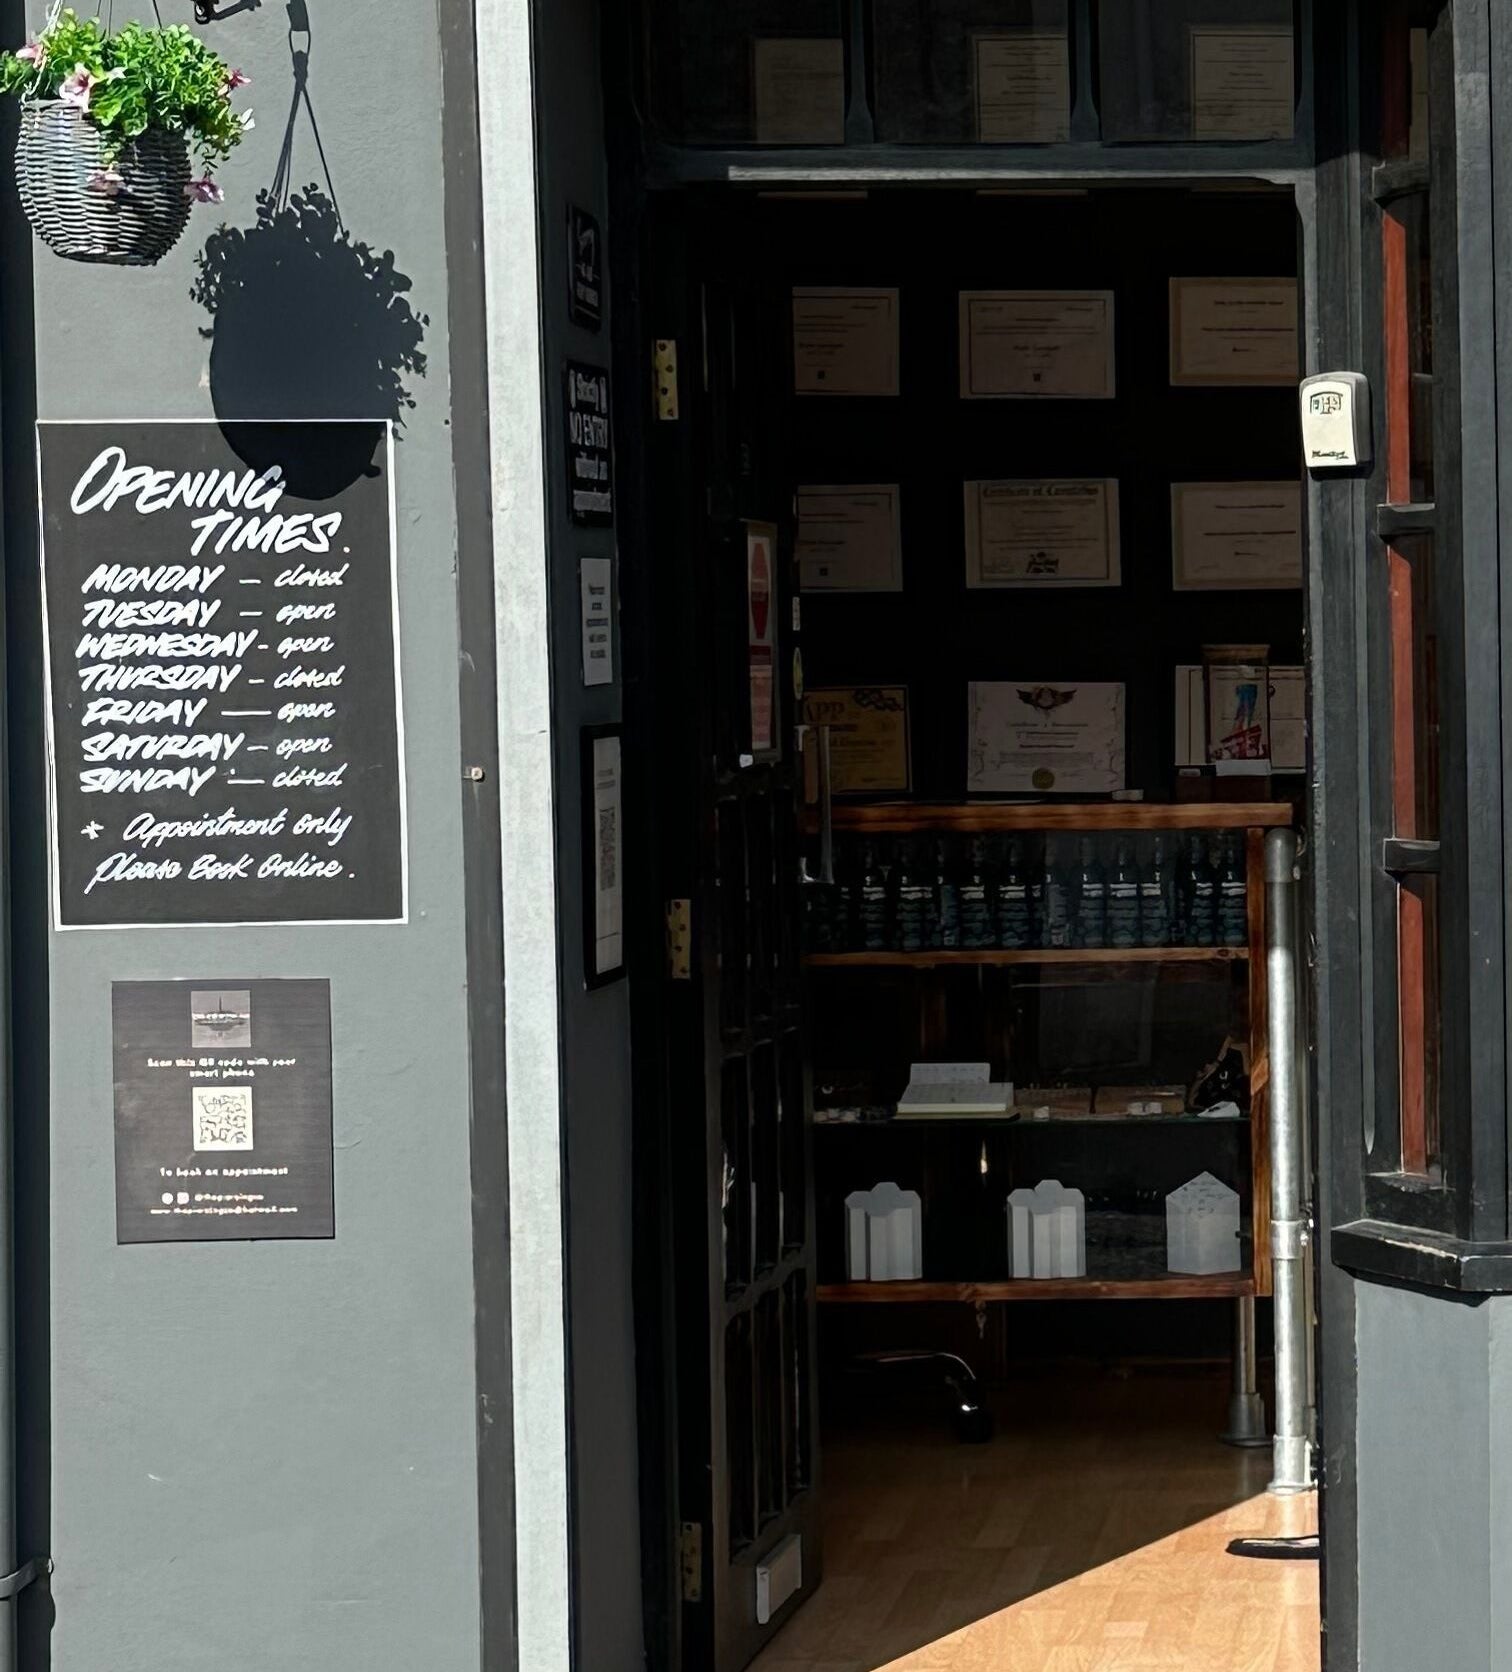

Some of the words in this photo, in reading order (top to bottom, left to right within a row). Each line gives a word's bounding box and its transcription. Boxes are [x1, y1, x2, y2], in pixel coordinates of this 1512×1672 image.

[70, 446, 286, 515] OPENING
[81, 563, 226, 594] MONDAY
[274, 562, 350, 588] closed
[81, 598, 222, 629] TUESDAY
[275, 602, 336, 626] open
[75, 628, 259, 661] WEDNESDAY
[276, 635, 335, 660] open
[78, 663, 243, 693] THURSDAY
[273, 664, 346, 690] closed
[81, 697, 208, 727] FRIDAY
[276, 701, 336, 724] open
[81, 731, 245, 762] SATURDAY
[275, 736, 333, 760] open
[79, 764, 217, 797] SUNDAY
[271, 762, 349, 789] closed
[217, 1058, 243, 1067] code
[176, 1167, 202, 1177] book
[204, 1168, 219, 1177] an
[222, 1167, 289, 1178] appointment
